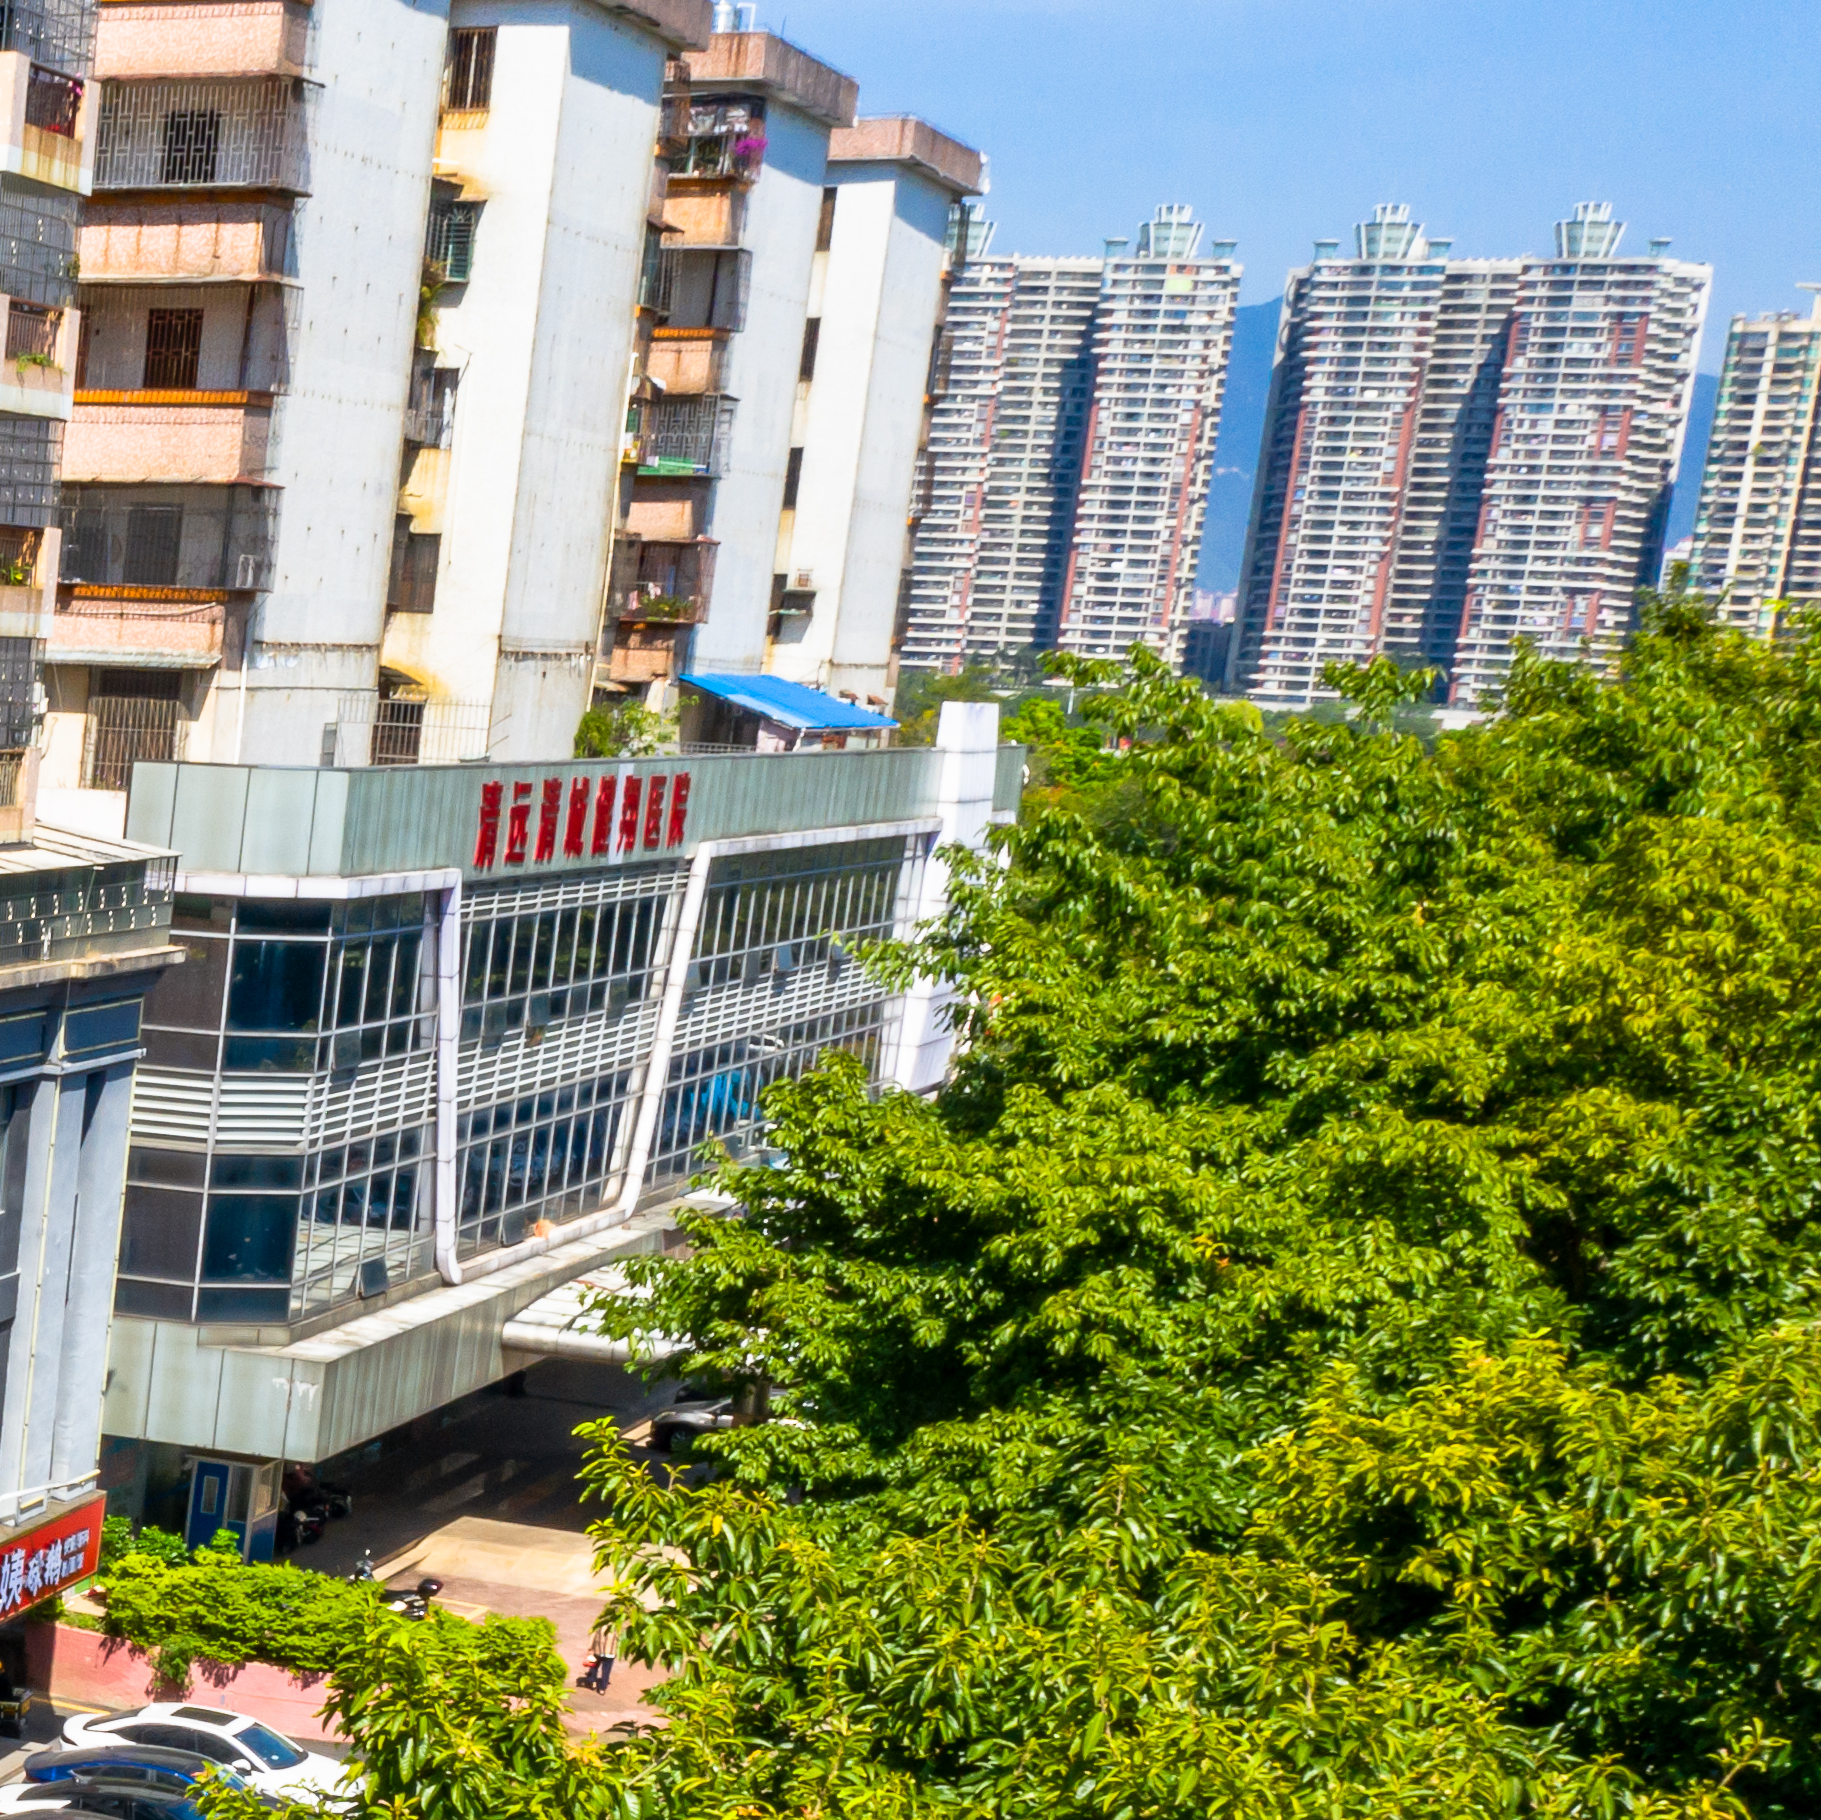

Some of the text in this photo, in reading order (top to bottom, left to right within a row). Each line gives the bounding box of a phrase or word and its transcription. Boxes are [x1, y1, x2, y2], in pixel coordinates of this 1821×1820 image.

[472, 770, 692, 873] 清远清城健翔医院
